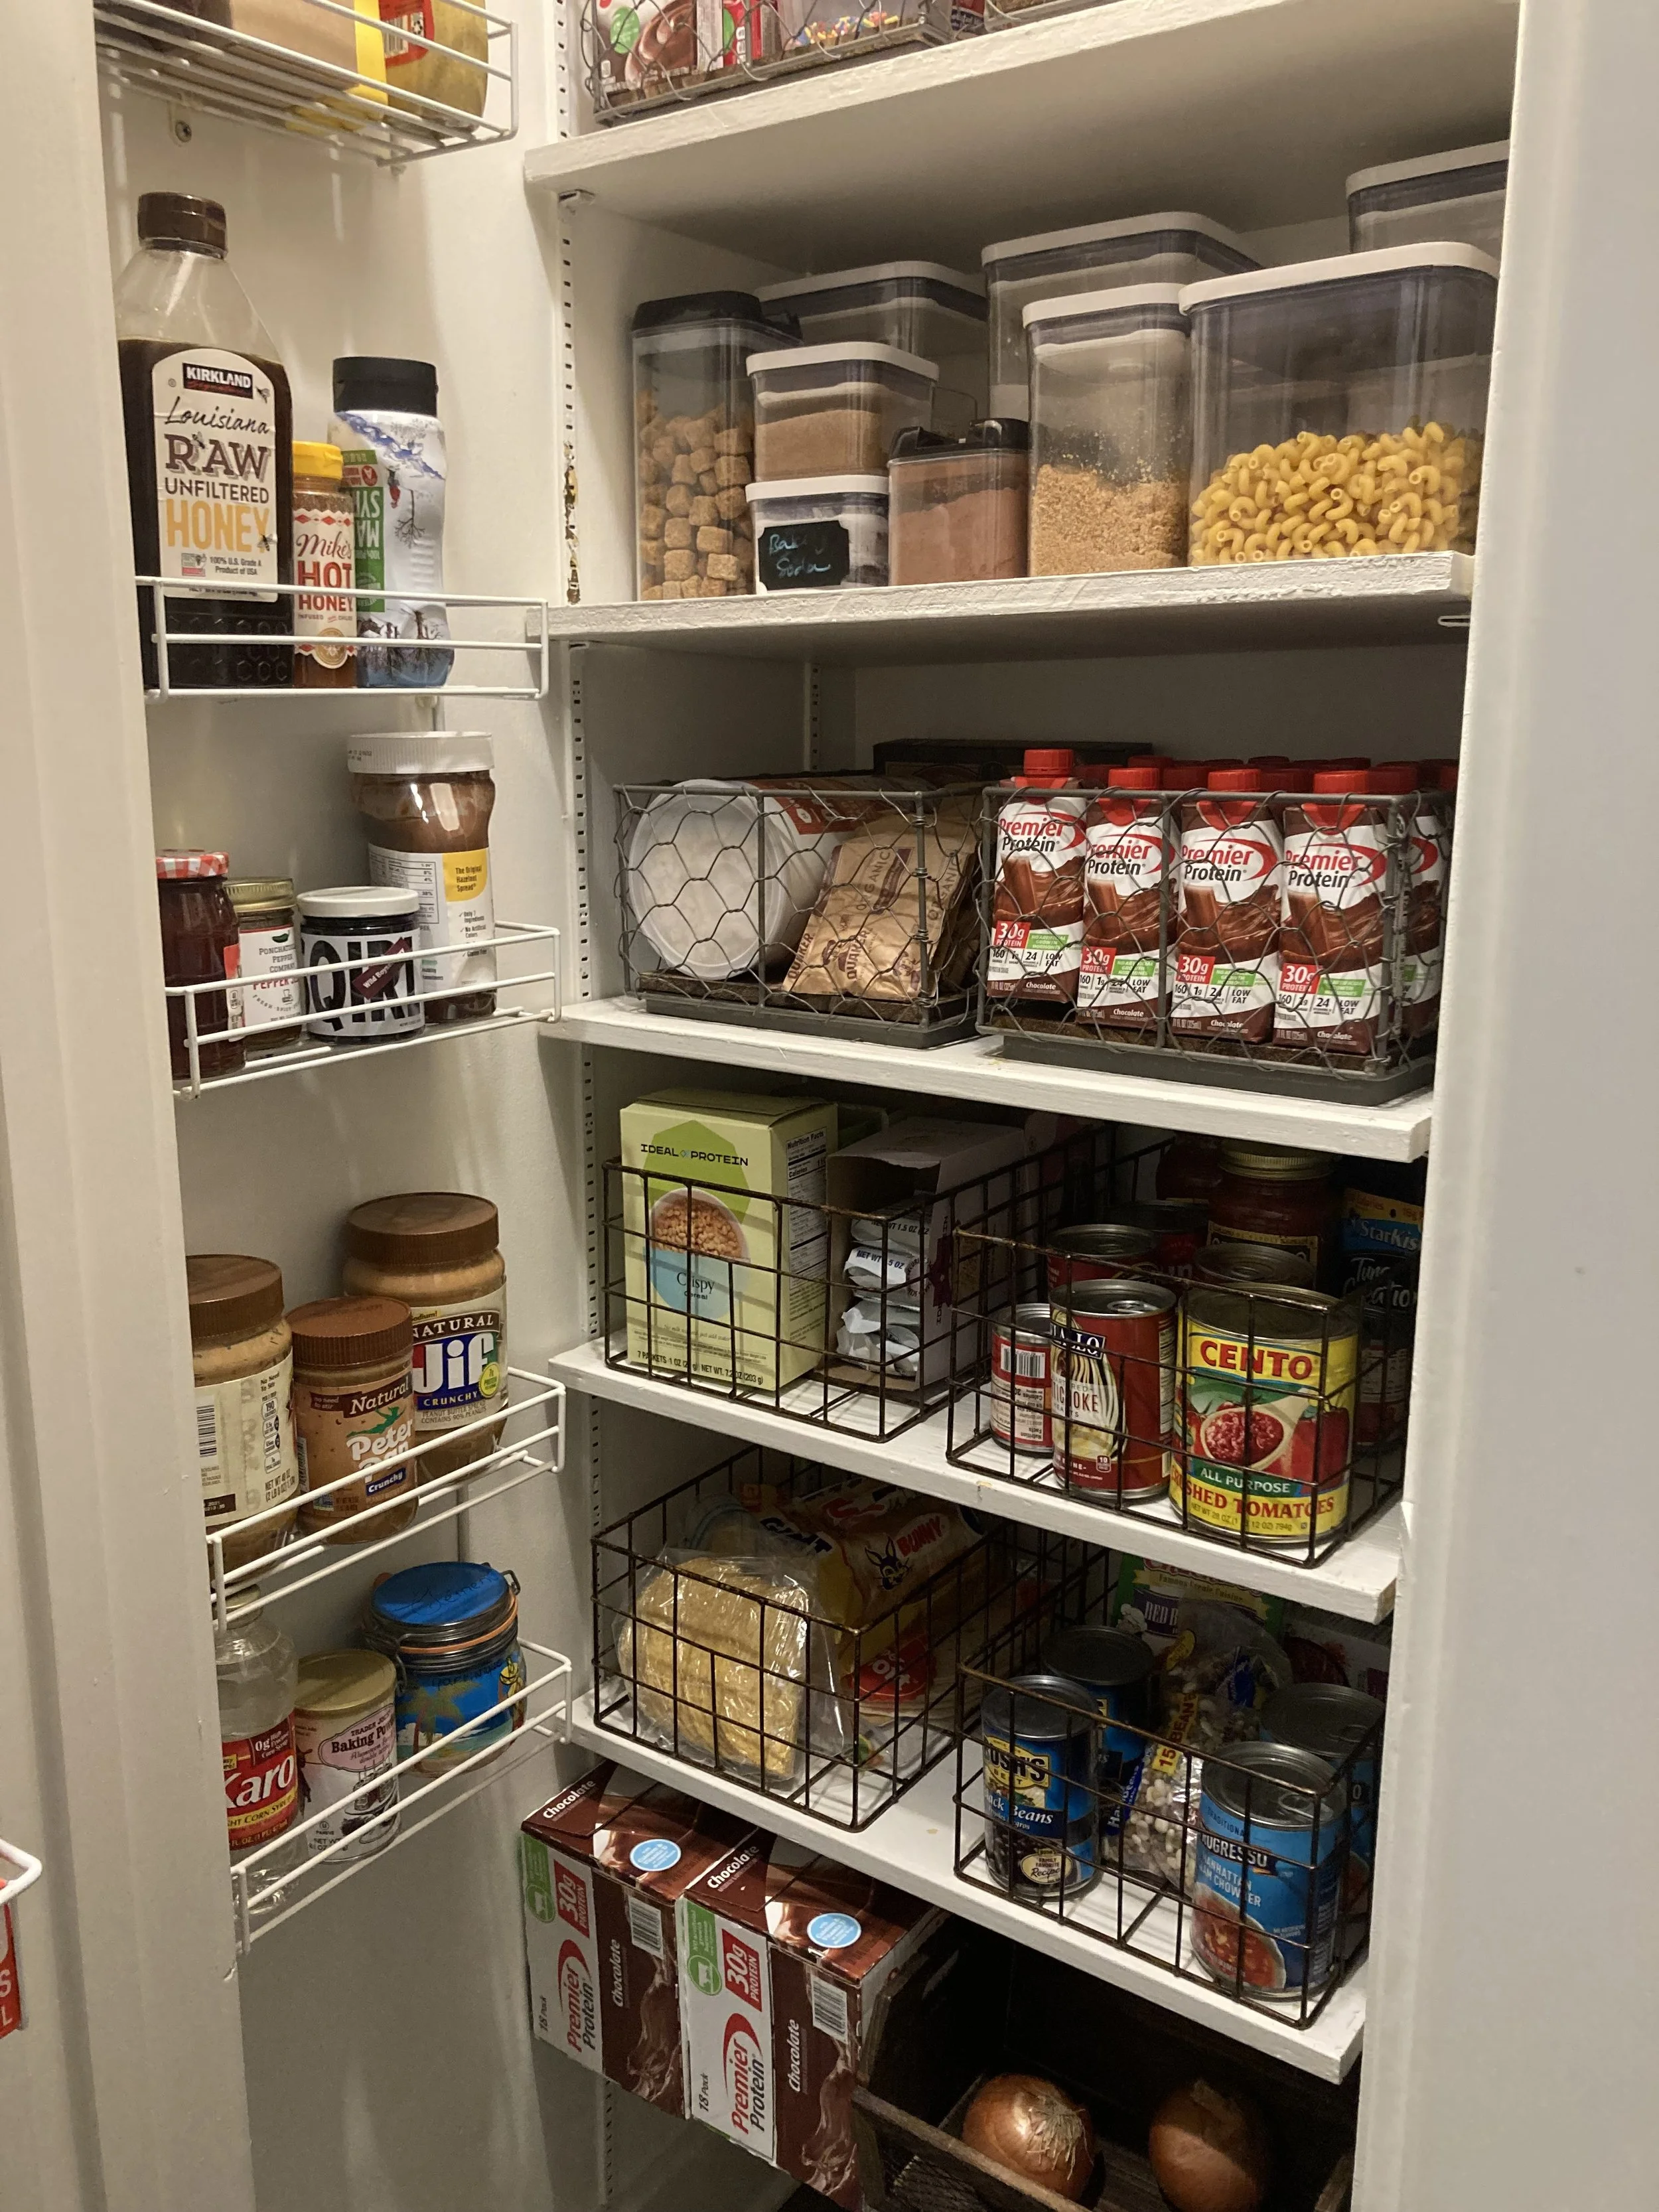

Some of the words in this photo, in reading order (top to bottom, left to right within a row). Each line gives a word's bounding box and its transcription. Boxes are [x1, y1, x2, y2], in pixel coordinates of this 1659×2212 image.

[186, 367, 251, 388] KIRKLAND
[165, 396, 270, 433] Louisiana
[164, 433, 271, 482] RAW
[165, 478, 269, 504] UNFILTERED
[167, 498, 269, 553] HONEY
[297, 532, 352, 559] Mike's
[297, 560, 352, 589] HOT
[299, 595, 352, 611] HONEY
[999, 818, 1066, 837] Premier
[1002, 836, 1056, 853] Protein
[1181, 844, 1254, 866] Premier
[1088, 858, 1141, 875] Protein
[1285, 848, 1363, 873] Premier
[457, 875, 477, 883] Hazelnut
[1185, 865, 1242, 882] Protein
[1288, 870, 1349, 888] Protein
[997, 922, 1025, 940] 30g
[787, 932, 814, 980] QUAKER
[846, 928, 869, 980] QUAKER
[992, 948, 1005, 958] 160
[1025, 952, 1038, 961] 24
[1083, 948, 1110, 965] 30g
[1180, 956, 1209, 975] 30g
[1284, 965, 1315, 984] 30g
[363, 976, 377, 988] Wild
[1026, 982, 1056, 990] Chocolate
[1080, 974, 1091, 984] 160
[1175, 984, 1187, 994] 160
[1194, 986, 1202, 995] 1g
[1277, 994, 1292, 1004] 160
[1316, 997, 1330, 1007] 24
[1113, 1008, 1144, 1017] Chocolate
[788, 1136, 810, 1149] Nutrition
[810, 1131, 824, 1140] Facts
[640, 1143, 679, 1157] IDEAL
[691, 1151, 749, 1167] PROTEIN
[789, 1167, 808, 1178] Calories
[897, 1223, 907, 1232] 1.5
[857, 1250, 869, 1260] NET
[871, 1253, 882, 1263] WT
[894, 1261, 904, 1270] OZ
[676, 1271, 715, 1294] Cispy
[413, 1315, 494, 1338] NATURAL
[413, 1332, 494, 1393] Jif
[642, 1352, 667, 1364] PAKETS
[674, 1358, 682, 1367] OZ
[743, 1372, 757, 1382] (203
[757, 1376, 763, 1385] g)
[1200, 1340, 1313, 1380] CENTO
[349, 1376, 409, 1415] Natural
[423, 1390, 478, 1406] CRUNCHY
[346, 1419, 413, 1461] Peter
[368, 1471, 403, 1493] Crunchy
[1200, 1467, 1222, 1483] ALL
[1227, 1475, 1291, 1493] PURPOSE
[1190, 1502, 1201, 1512] NET
[1201, 1507, 1210, 1516] WT
[1212, 1510, 1220, 1520] 28
[1221, 1514, 1230, 1523] OZ
[1252, 1521, 1260, 1530] 12
[1275, 1523, 1293, 1532] 794g
[895, 1515, 944, 1558] BUNNY
[1159, 1574, 1188, 1587] Famous
[1145, 1601, 1168, 1625] RED
[351, 1722, 376, 1736] TRADER
[255, 1738, 270, 1752] 0g
[332, 1731, 374, 1754] Baking
[1159, 1748, 1177, 1767] 15
[543, 1779, 596, 1819] Chocolate
[244, 1808, 269, 1824] CORN
[1012, 1804, 1054, 1825] Beans
[1207, 1806, 1245, 1838] TRADITIONA
[707, 1845, 760, 1889] Chocolate
[1031, 1866, 1061, 1880] Recipe
[559, 1874, 579, 1922] 30g
[1214, 1876, 1262, 1908] CHOWER
[611, 1939, 624, 2008] Chocolate
[727, 1943, 749, 1995] 30g
[747, 1954, 760, 2002] PROTEIN
[567, 1960, 583, 2054] Premier
[581, 1978, 597, 2051] Protein
[788, 2018, 800, 2093] Chocolate
[700, 2072, 709, 2091] Pack
[731, 2037, 749, 2136] Premier
[698, 2093, 709, 2113] 18
[749, 2057, 765, 2132] Protein
